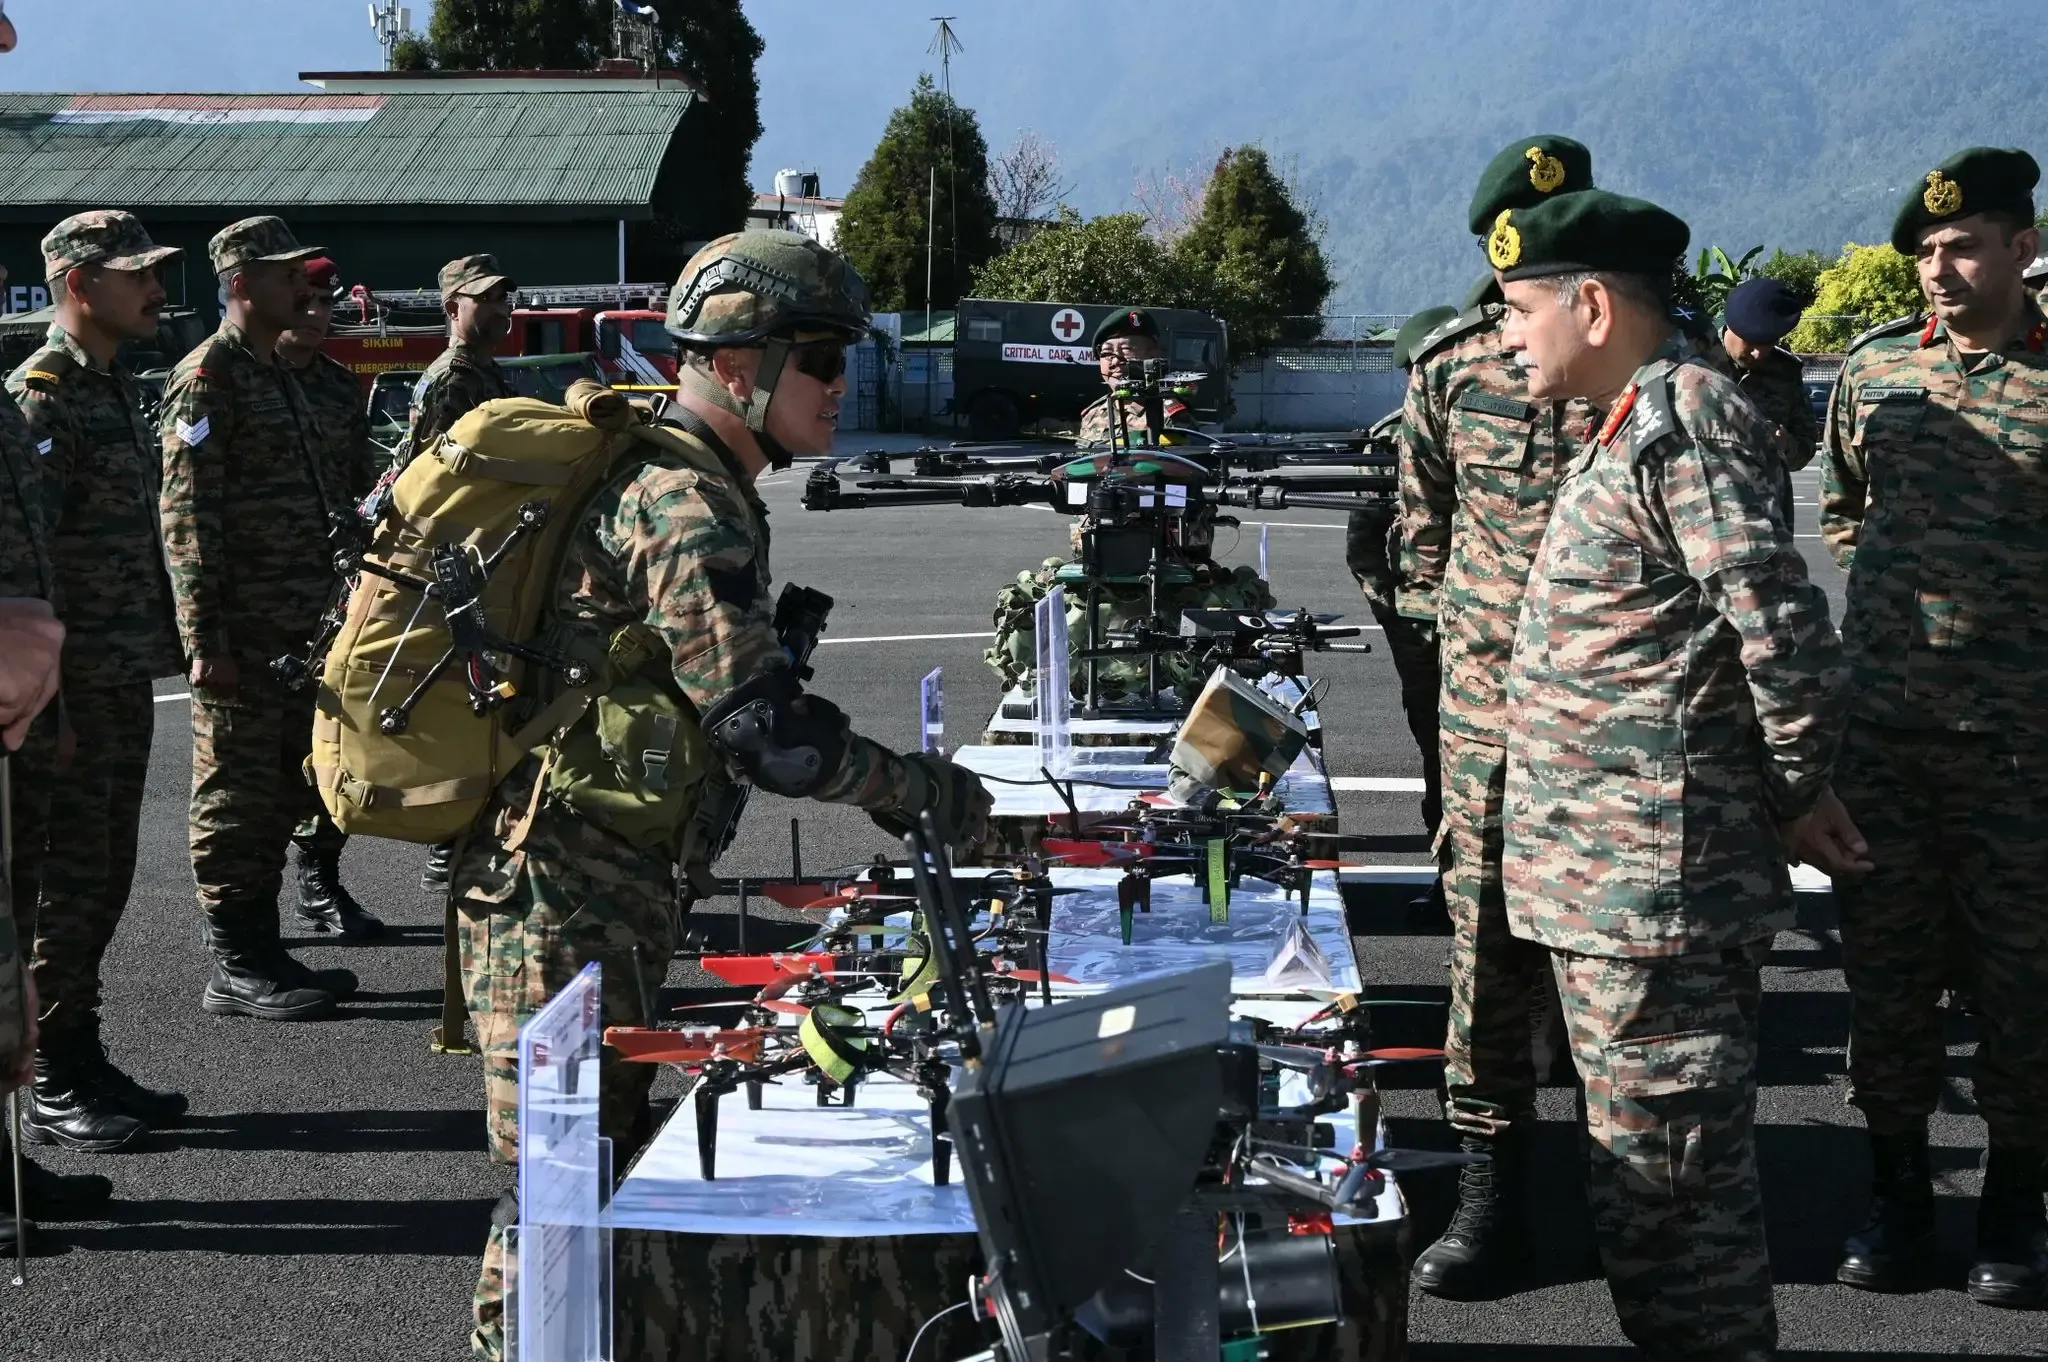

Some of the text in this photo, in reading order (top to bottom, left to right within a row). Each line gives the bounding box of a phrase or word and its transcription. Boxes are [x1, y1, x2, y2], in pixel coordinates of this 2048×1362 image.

[362, 338, 404, 348] SIKKIM
[1004, 347, 1044, 359] CRITICAL
[355, 363, 405, 373] EMERGENCY
[1864, 390, 1918, 398] NITIN BHATIA
